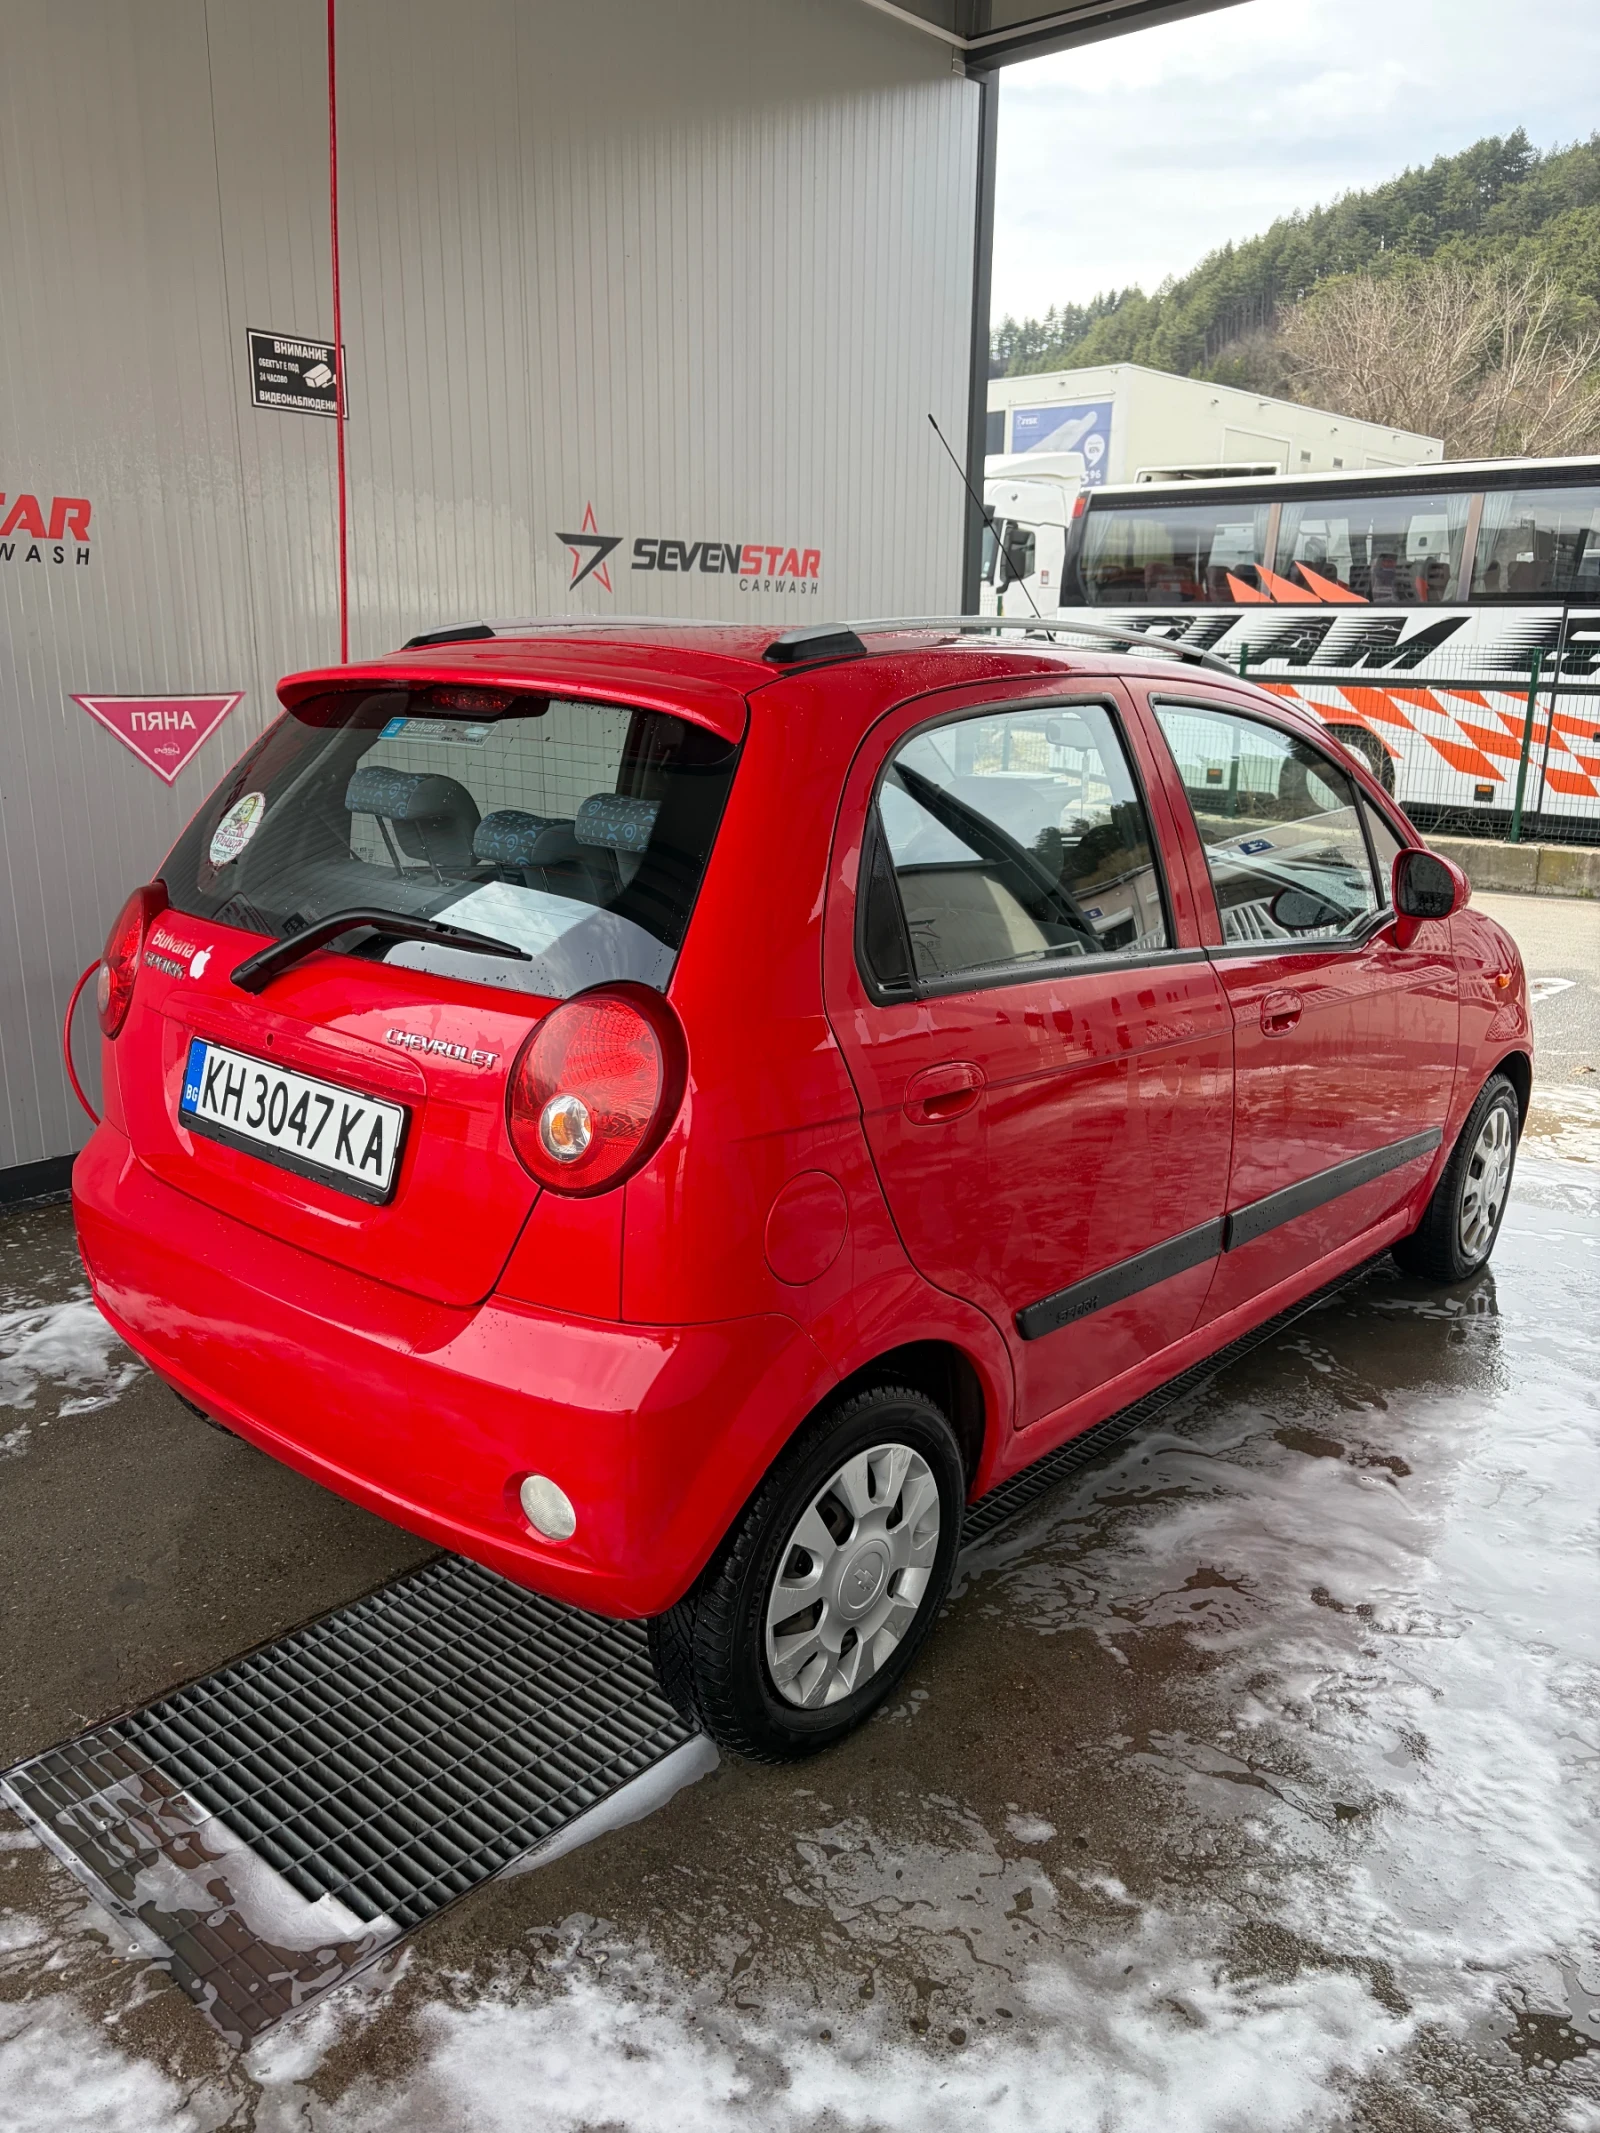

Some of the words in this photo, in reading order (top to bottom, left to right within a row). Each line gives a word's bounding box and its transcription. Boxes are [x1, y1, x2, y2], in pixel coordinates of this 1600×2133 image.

[273, 341, 328, 361] ВНИМАНИЕ
[258, 358, 283, 370] ОБЕКТЪТ
[287, 362, 300, 374] ПОД
[259, 372, 266, 381] 24
[267, 373, 288, 383] ЧАСОВО
[259, 390, 338, 412] ВИДЕОНАБЛЮДЕНИ
[0, 492, 92, 541] AR
[0, 542, 90, 565] WASH
[739, 578, 819, 595] CARWASH
[130, 710, 197, 732] ПЯНА
[386, 1028, 500, 1070] CHEVROLET
[185, 1083, 199, 1103] BG
